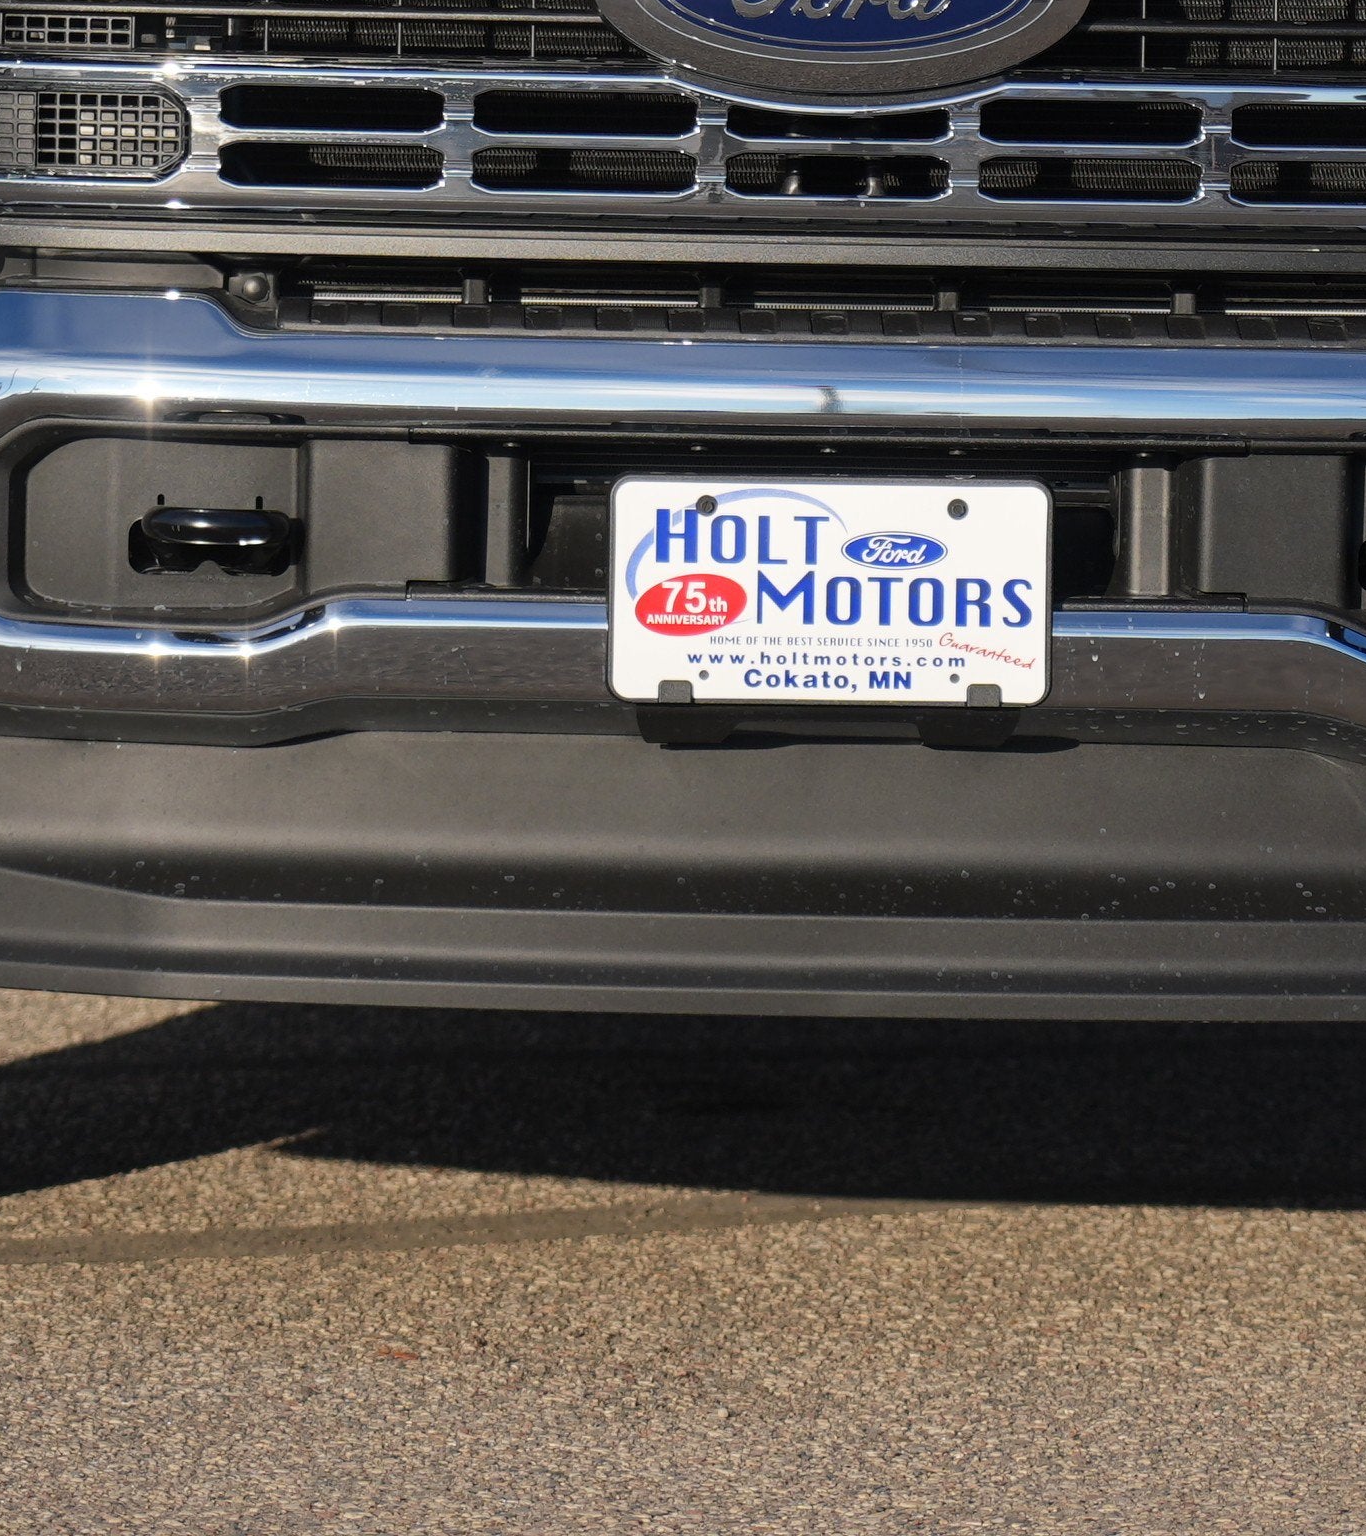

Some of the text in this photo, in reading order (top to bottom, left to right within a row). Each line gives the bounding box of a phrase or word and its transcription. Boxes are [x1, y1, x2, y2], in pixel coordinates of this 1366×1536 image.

[655, 508, 830, 566] HOLT
[861, 536, 928, 565] Ford
[661, 581, 728, 613] 75th
[756, 570, 1033, 629] MOTORS
[646, 612, 727, 627] ANNIVERSARY
[709, 636, 742, 646] HOME
[746, 636, 759, 646] OF
[763, 636, 783, 646] THE
[786, 636, 813, 647] BEST
[867, 637, 901, 648] SINCE
[904, 638, 934, 649] 1950
[939, 632, 1037, 670] Guaranteed
[687, 651, 967, 668] www.holtmotors.com
[743, 669, 913, 692] Cokato, MN
